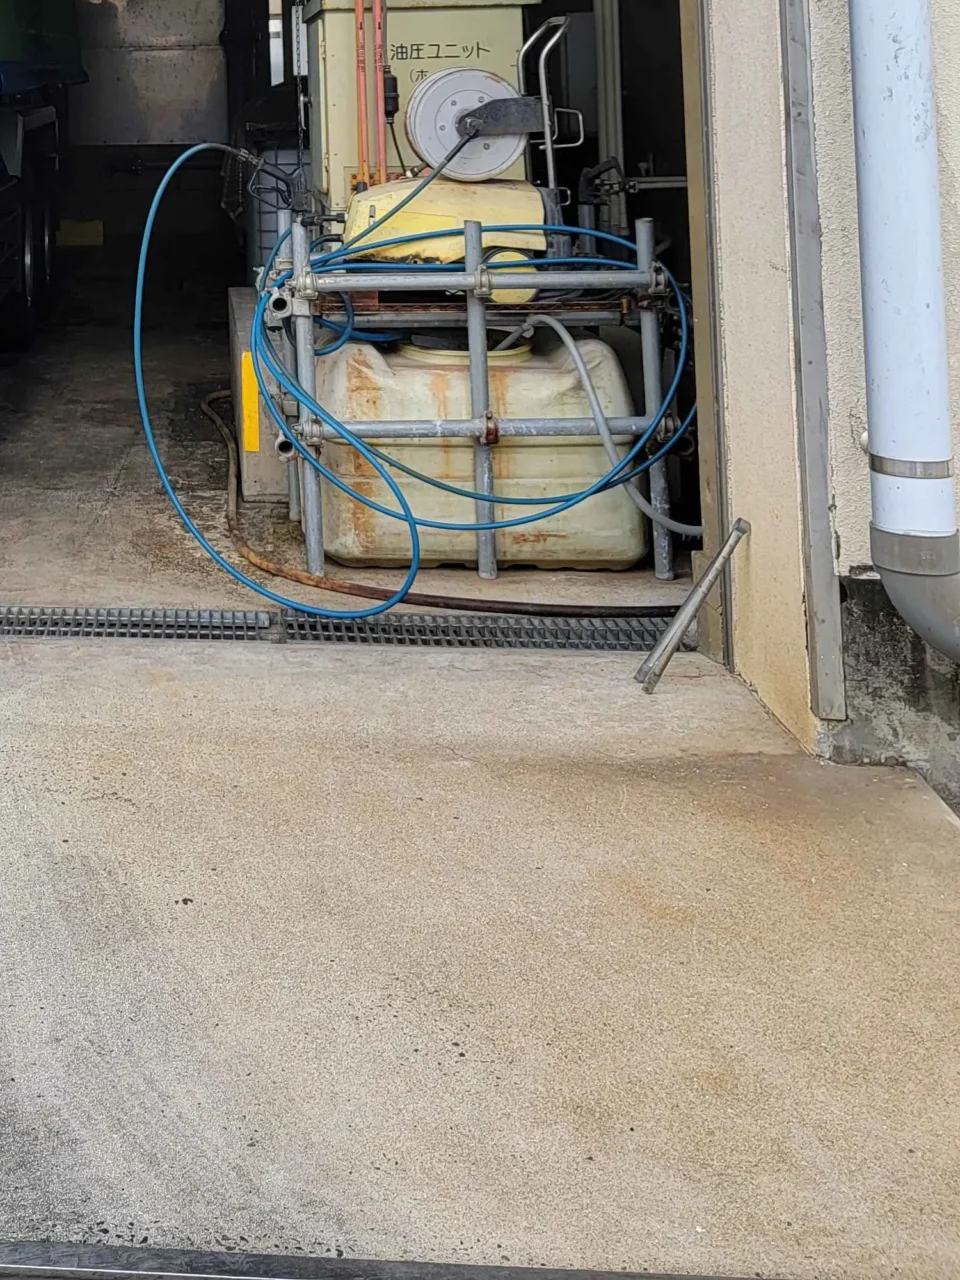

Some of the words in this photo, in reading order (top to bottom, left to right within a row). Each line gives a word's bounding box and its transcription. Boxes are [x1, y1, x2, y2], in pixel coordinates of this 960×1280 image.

[390, 41, 491, 61] 油圧ユニット
